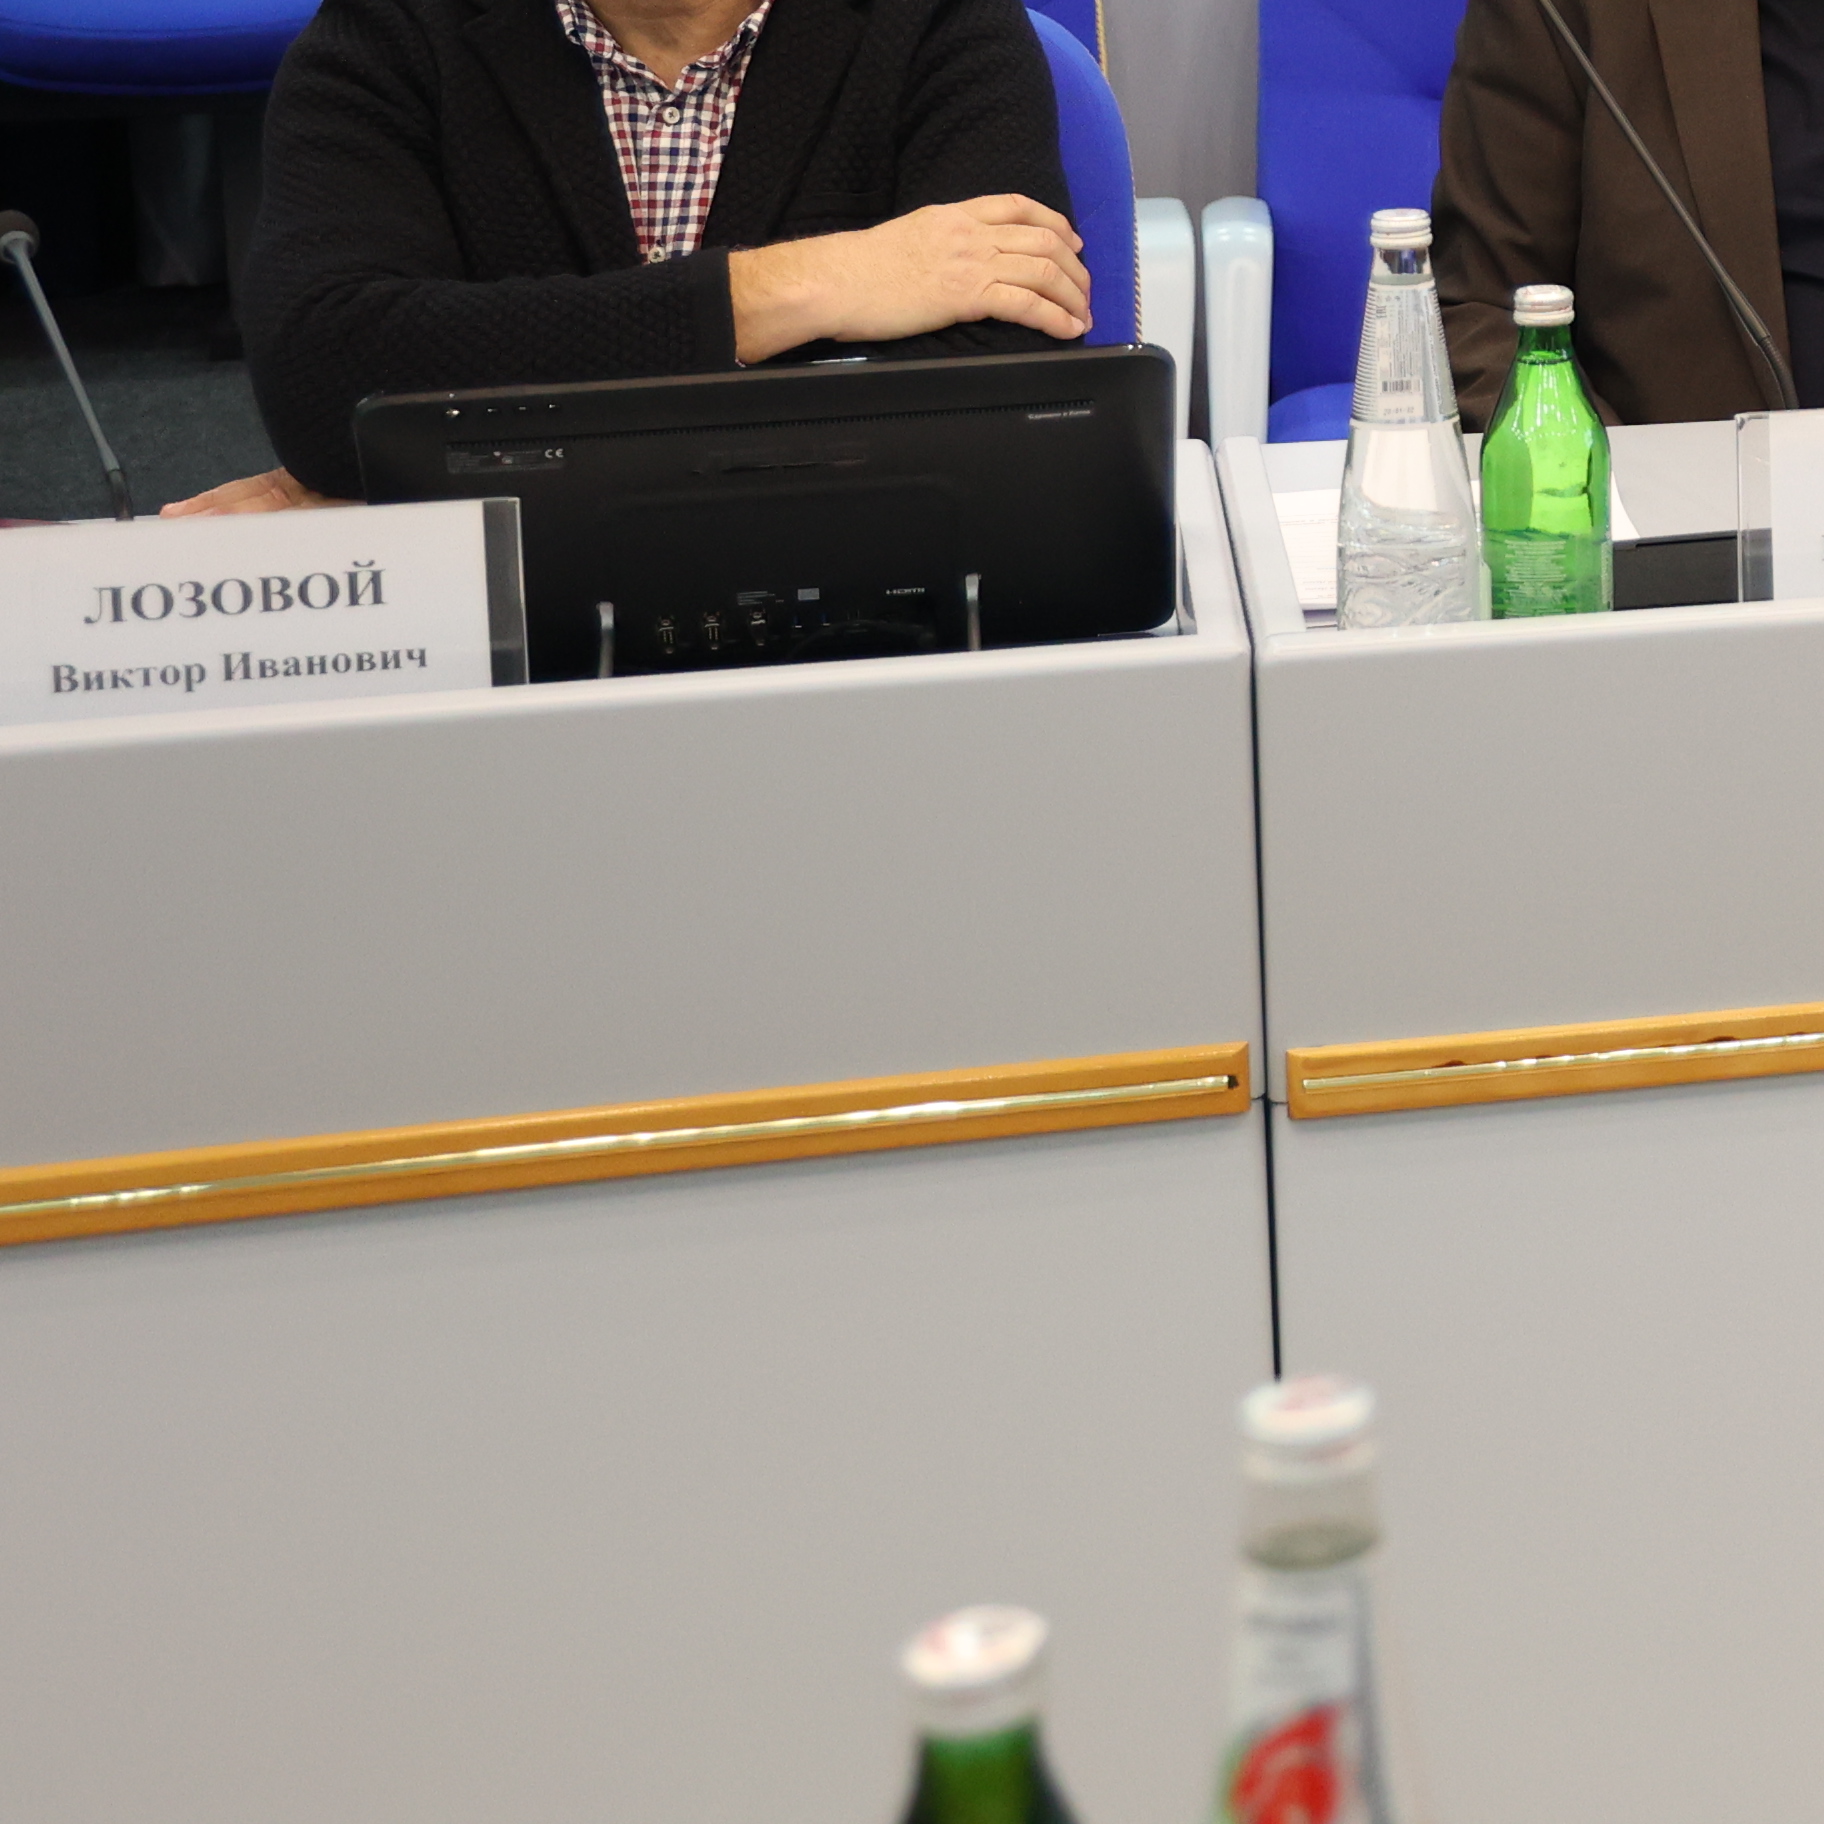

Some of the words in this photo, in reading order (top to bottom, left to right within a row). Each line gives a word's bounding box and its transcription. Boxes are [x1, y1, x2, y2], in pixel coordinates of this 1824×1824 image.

[82, 558, 388, 627] ЛОЗОВОЙ
[50, 658, 208, 696] Виктор
[220, 642, 430, 683] Иванович
